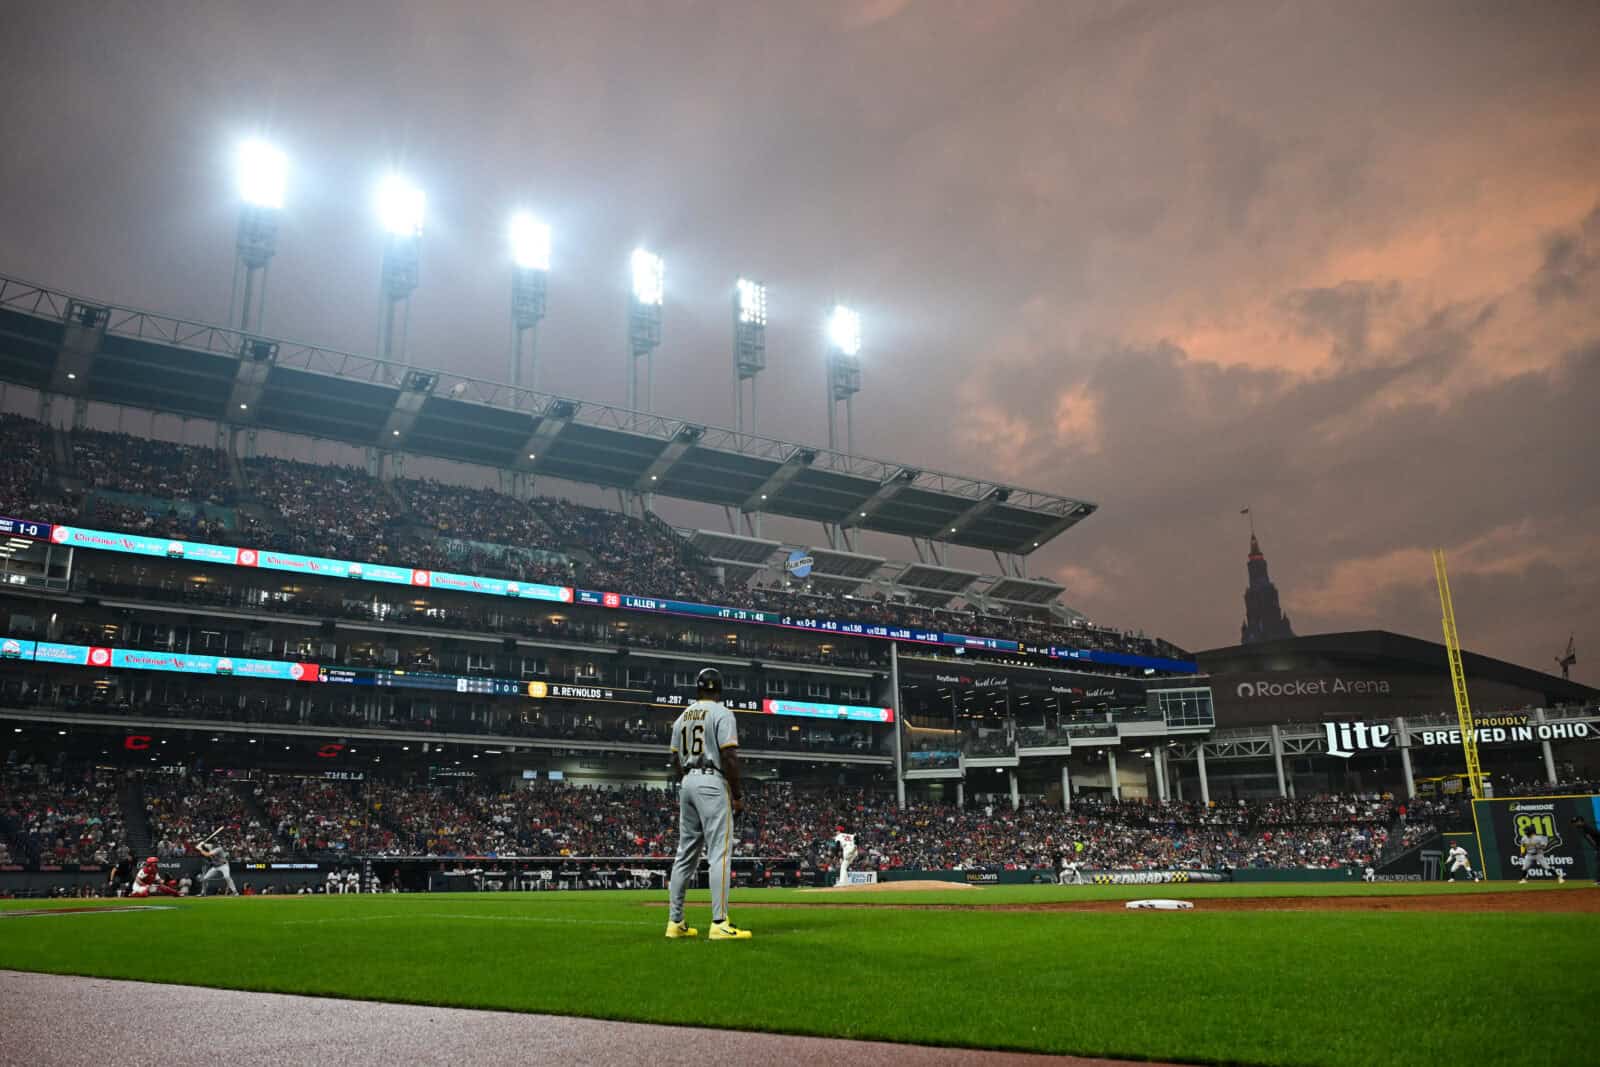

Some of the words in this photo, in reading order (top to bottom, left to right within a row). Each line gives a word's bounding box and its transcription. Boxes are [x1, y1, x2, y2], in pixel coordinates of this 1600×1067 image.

[20, 523, 38, 535] 1-0
[633, 599, 656, 608] ALLEN
[561, 687, 602, 698] REYNOLDS
[1256, 679, 1328, 696] Rocket
[1333, 677, 1391, 695] Arena
[1474, 716, 1529, 728] PROUDLY
[124, 735, 153, 750] C
[681, 725, 704, 756] 16
[1321, 721, 1392, 758] Lite
[1423, 726, 1508, 746] BREWED
[1512, 725, 1533, 741] IN
[1537, 723, 1590, 741] OHIO
[1516, 815, 1554, 837] 811
